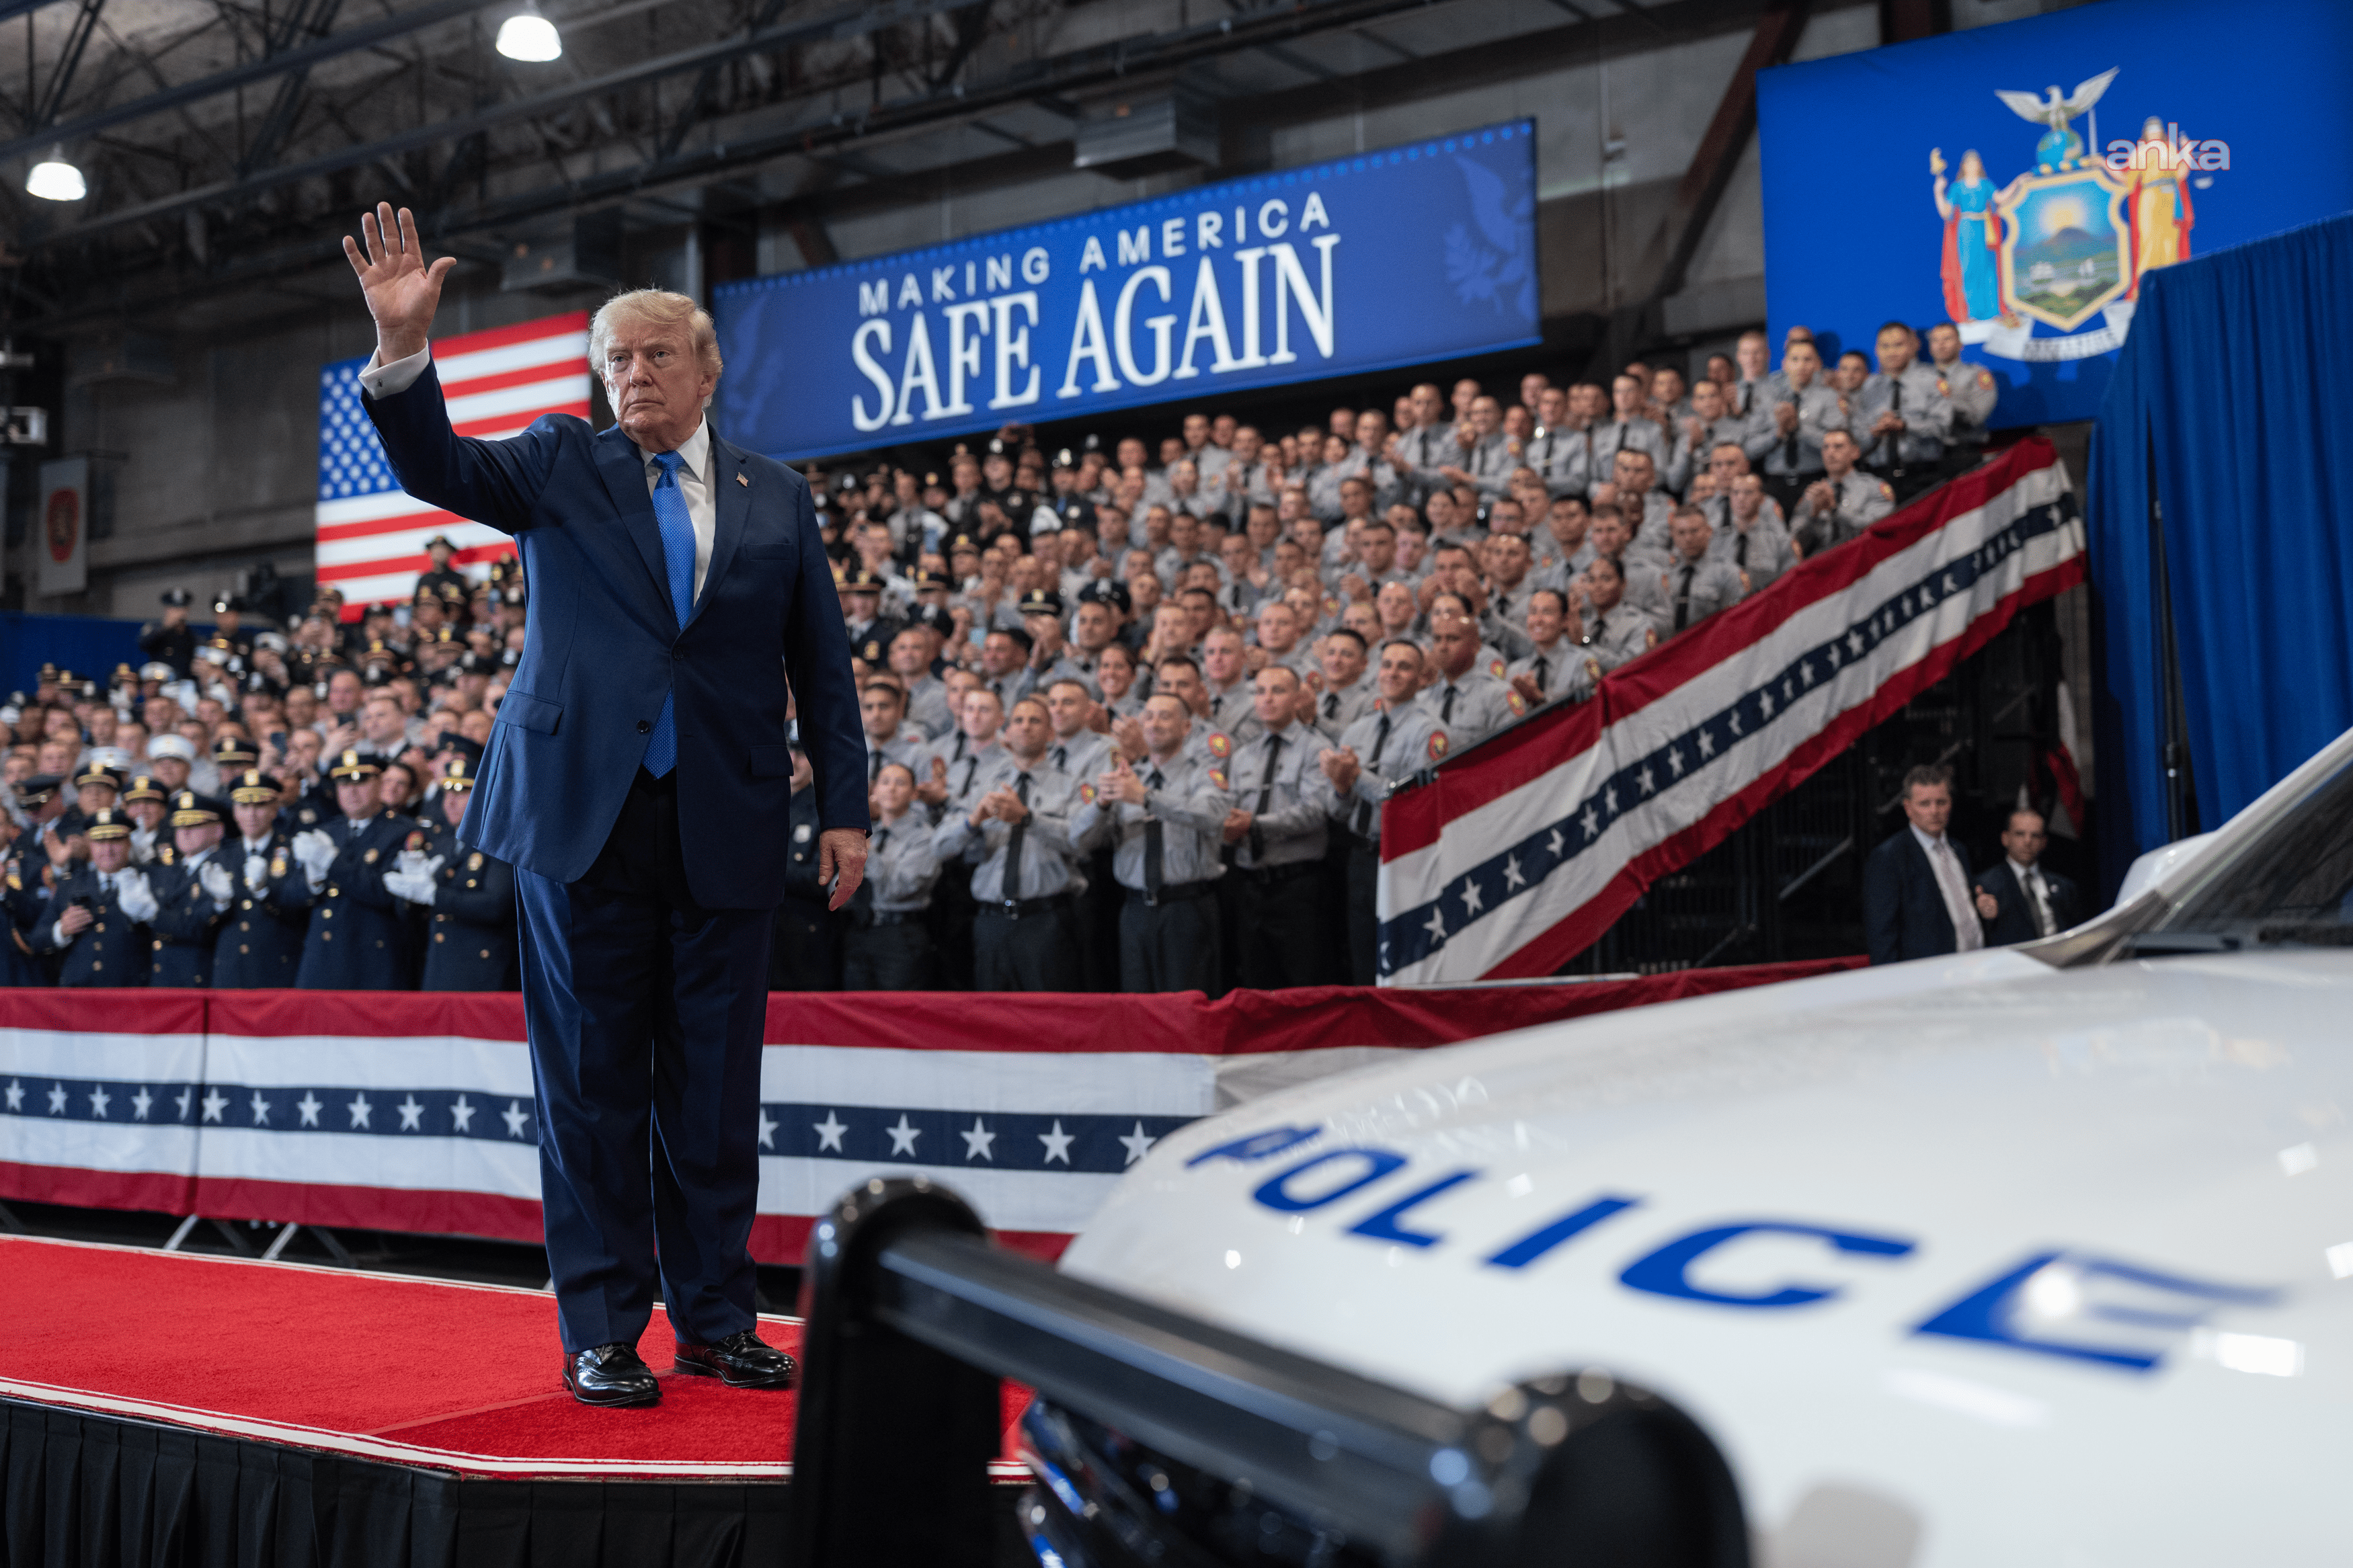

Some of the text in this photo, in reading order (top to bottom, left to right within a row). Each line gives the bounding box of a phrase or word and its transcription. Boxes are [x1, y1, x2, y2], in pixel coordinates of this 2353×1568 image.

[852, 233, 1341, 431] SAFE AGAIN
[859, 192, 1330, 316] MAKING AMERICA
[1185, 1122, 2289, 1374] POLICE
